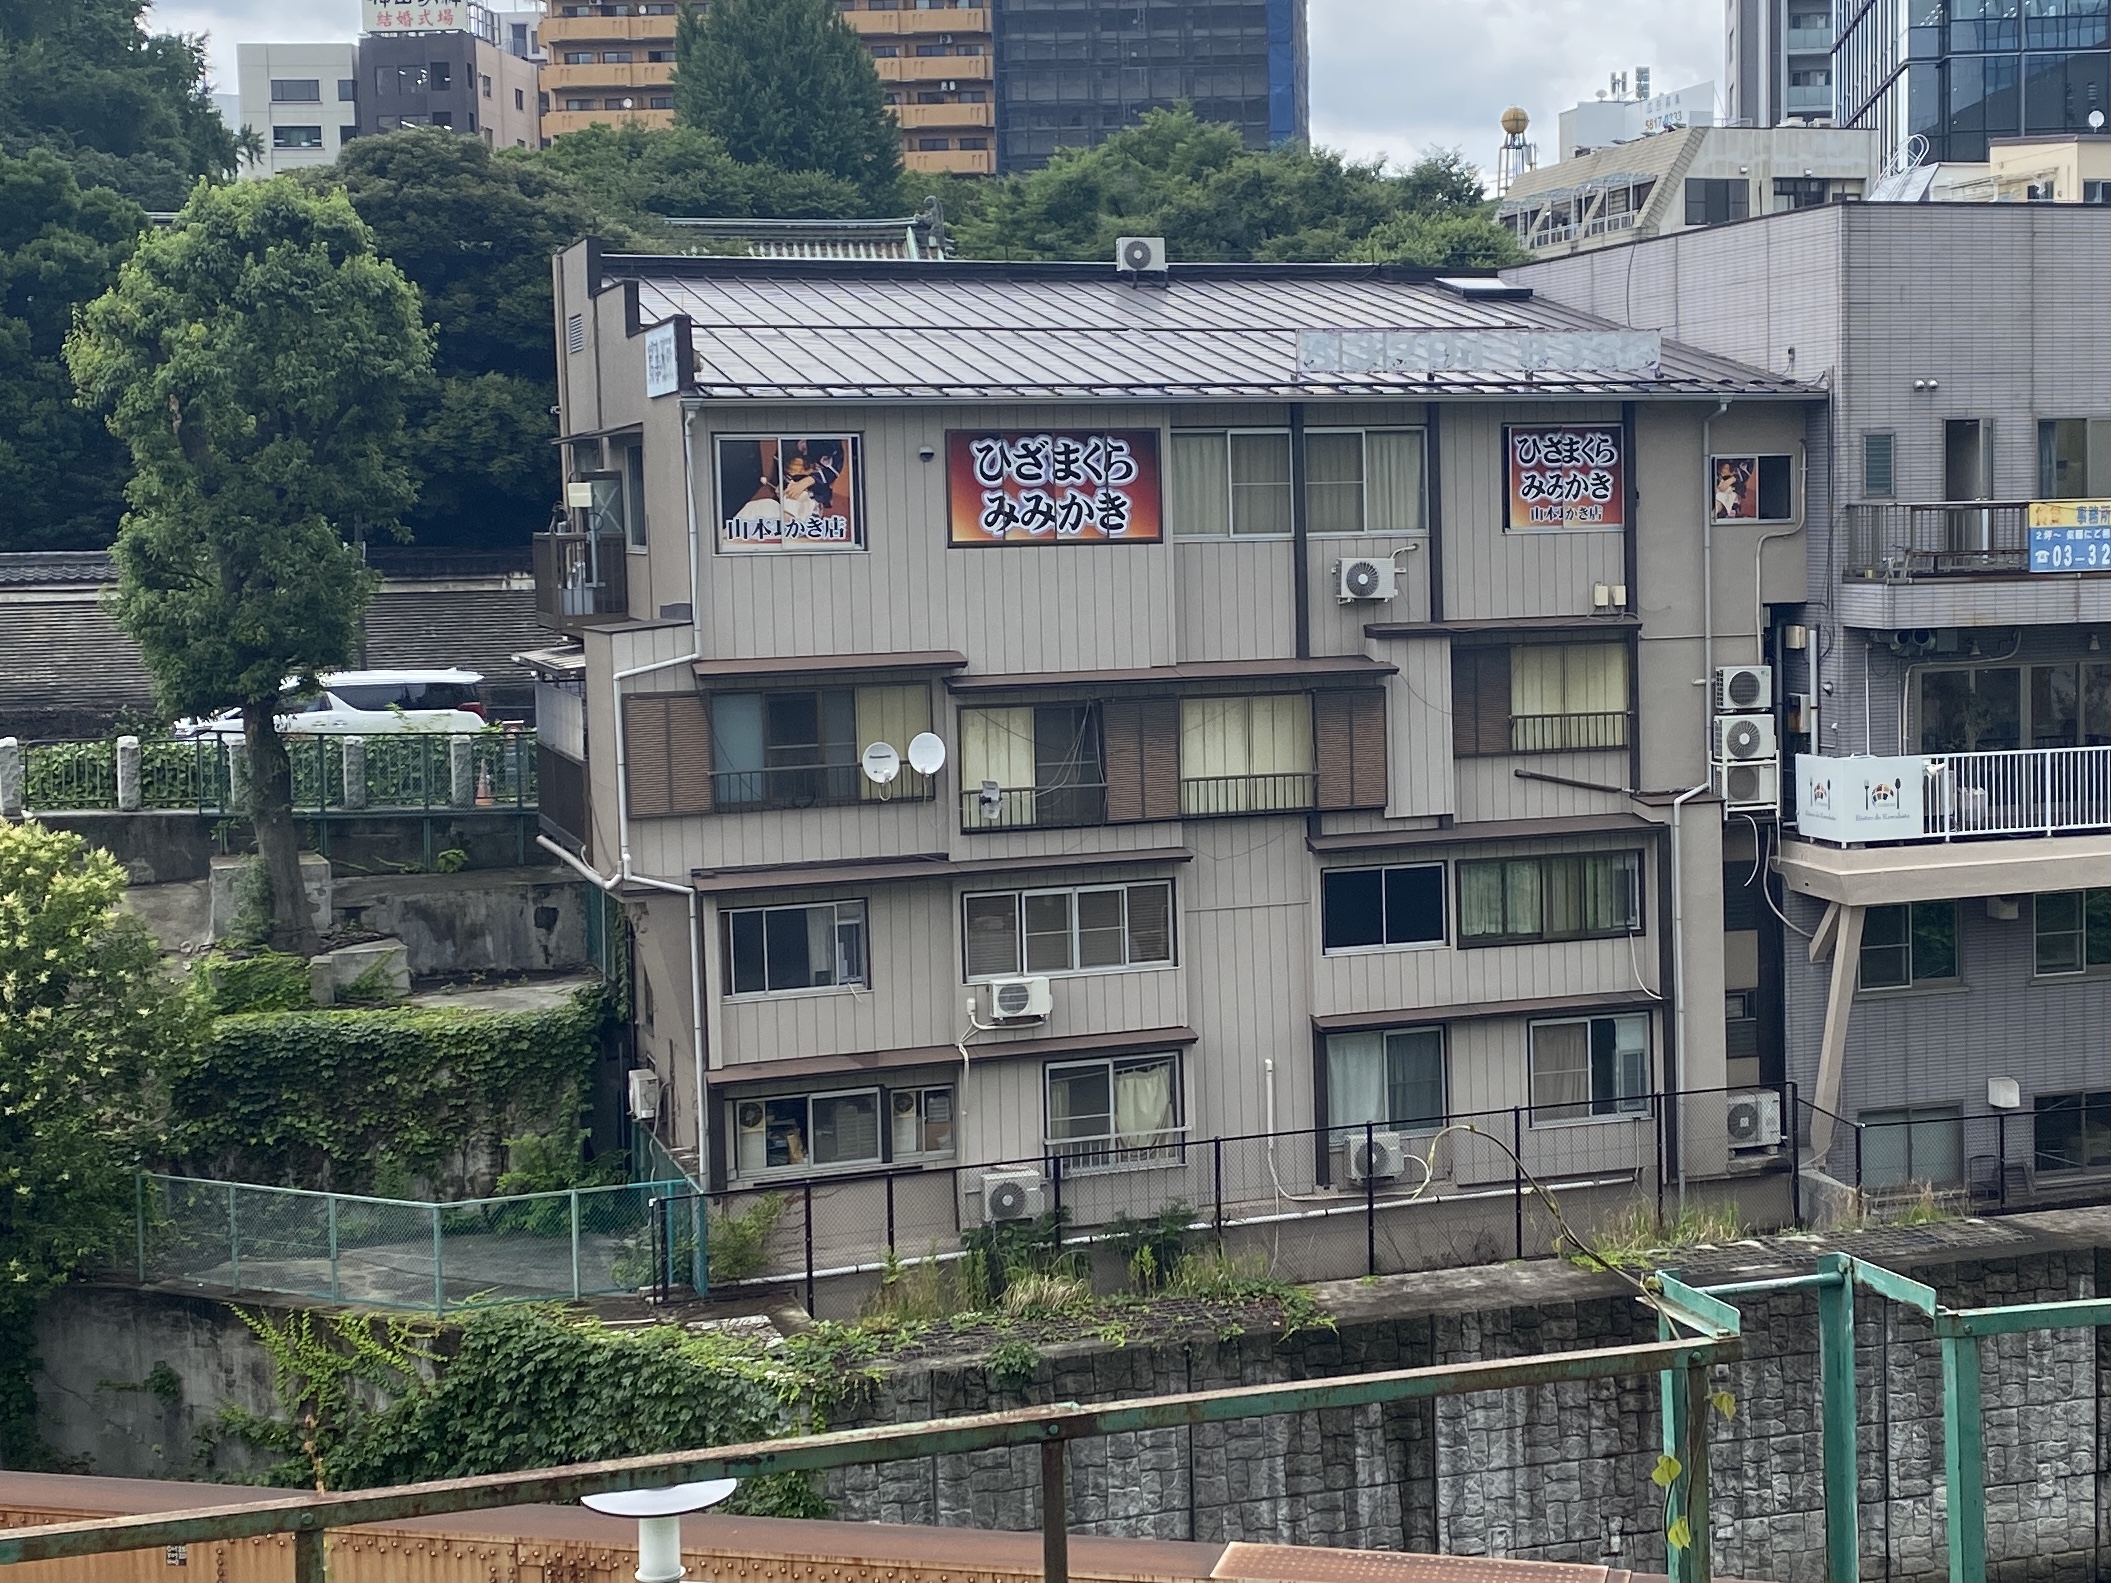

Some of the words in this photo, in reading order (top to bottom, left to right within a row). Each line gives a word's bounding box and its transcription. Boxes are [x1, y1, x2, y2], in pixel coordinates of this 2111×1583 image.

[376, 8, 454, 27] 結婚式場
[973, 438, 1135, 483] ひざまくら
[1520, 472, 1611, 500] みみかき
[982, 490, 1129, 533] みみかき
